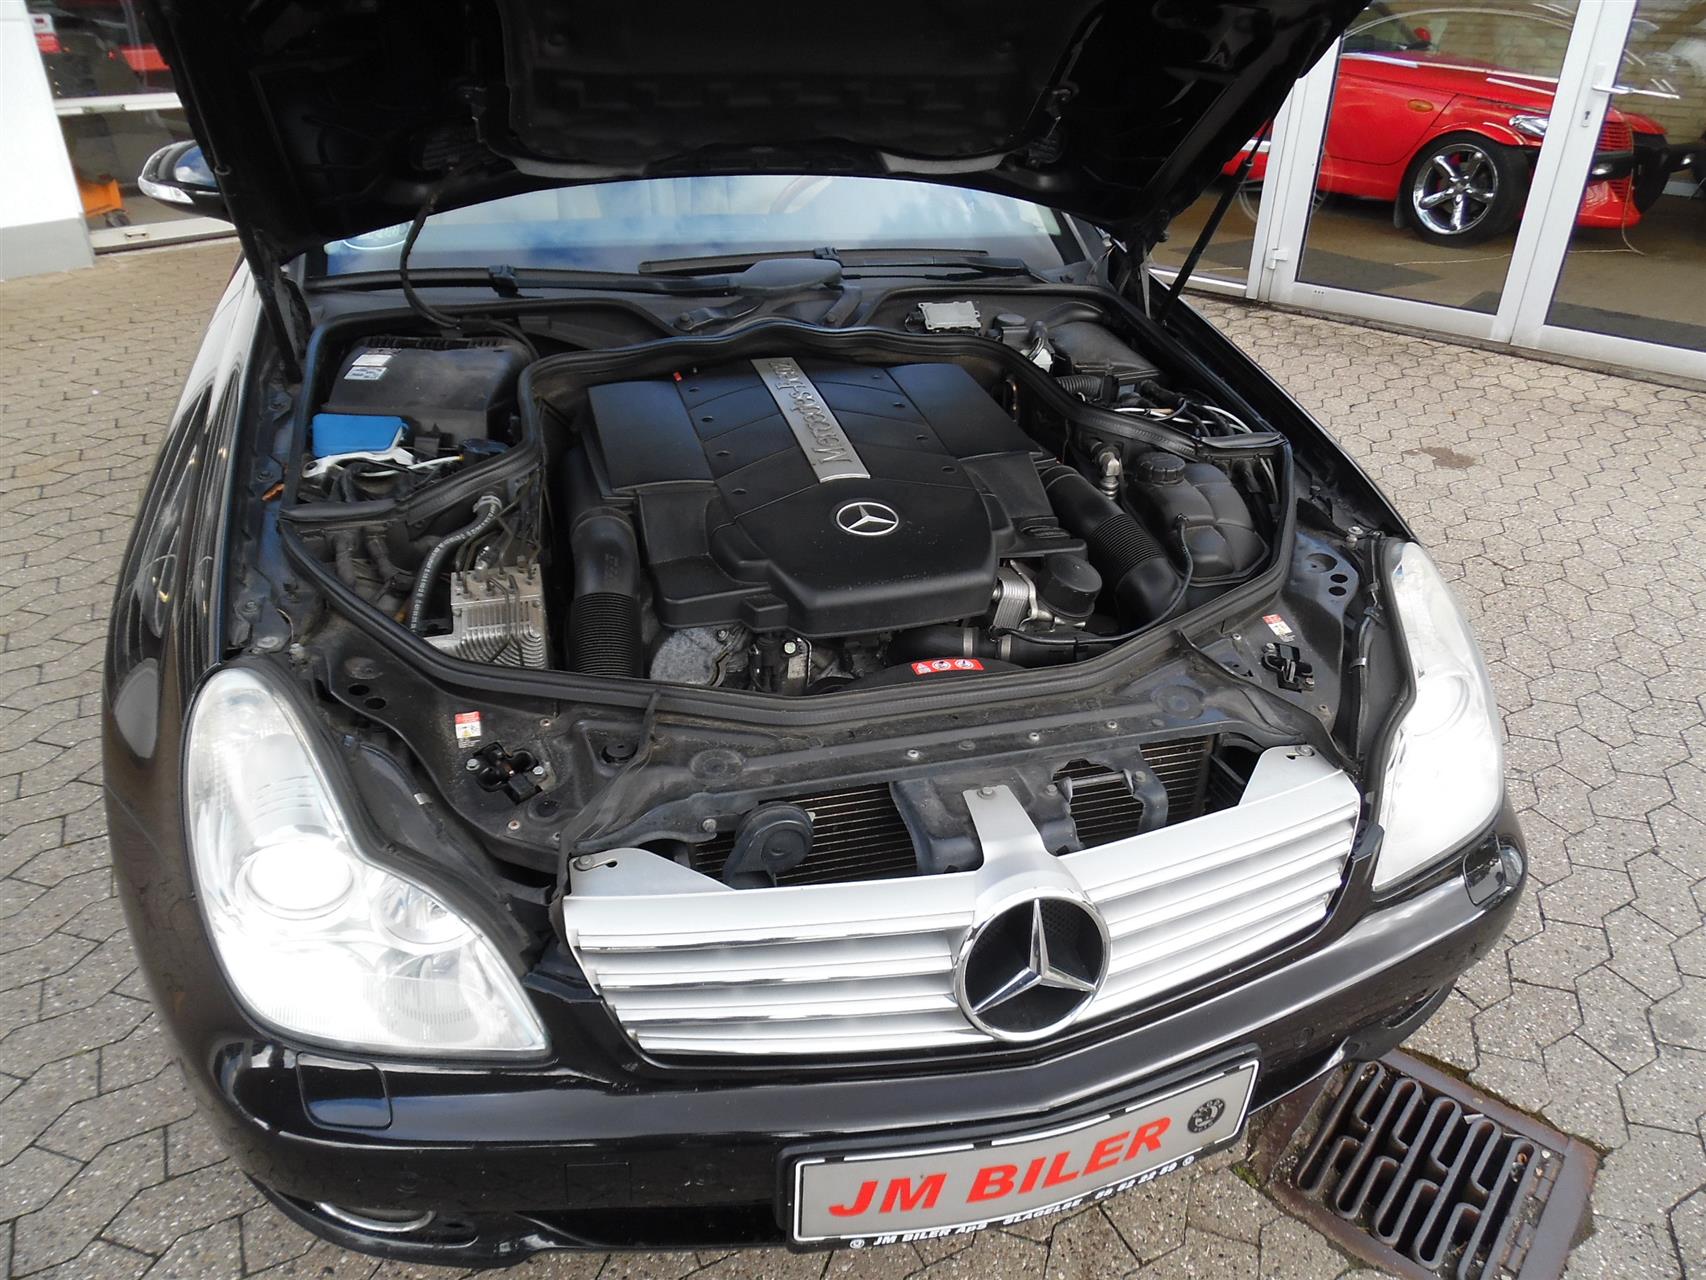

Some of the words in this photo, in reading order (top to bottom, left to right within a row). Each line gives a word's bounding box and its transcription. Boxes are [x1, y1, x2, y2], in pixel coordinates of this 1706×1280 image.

[768, 360, 853, 463] Mercedes-Benz
[828, 1172, 947, 1217] JM
[965, 1117, 1172, 1204] BILER
[873, 1235, 898, 1246] JM
[902, 1228, 951, 1242] BILER
